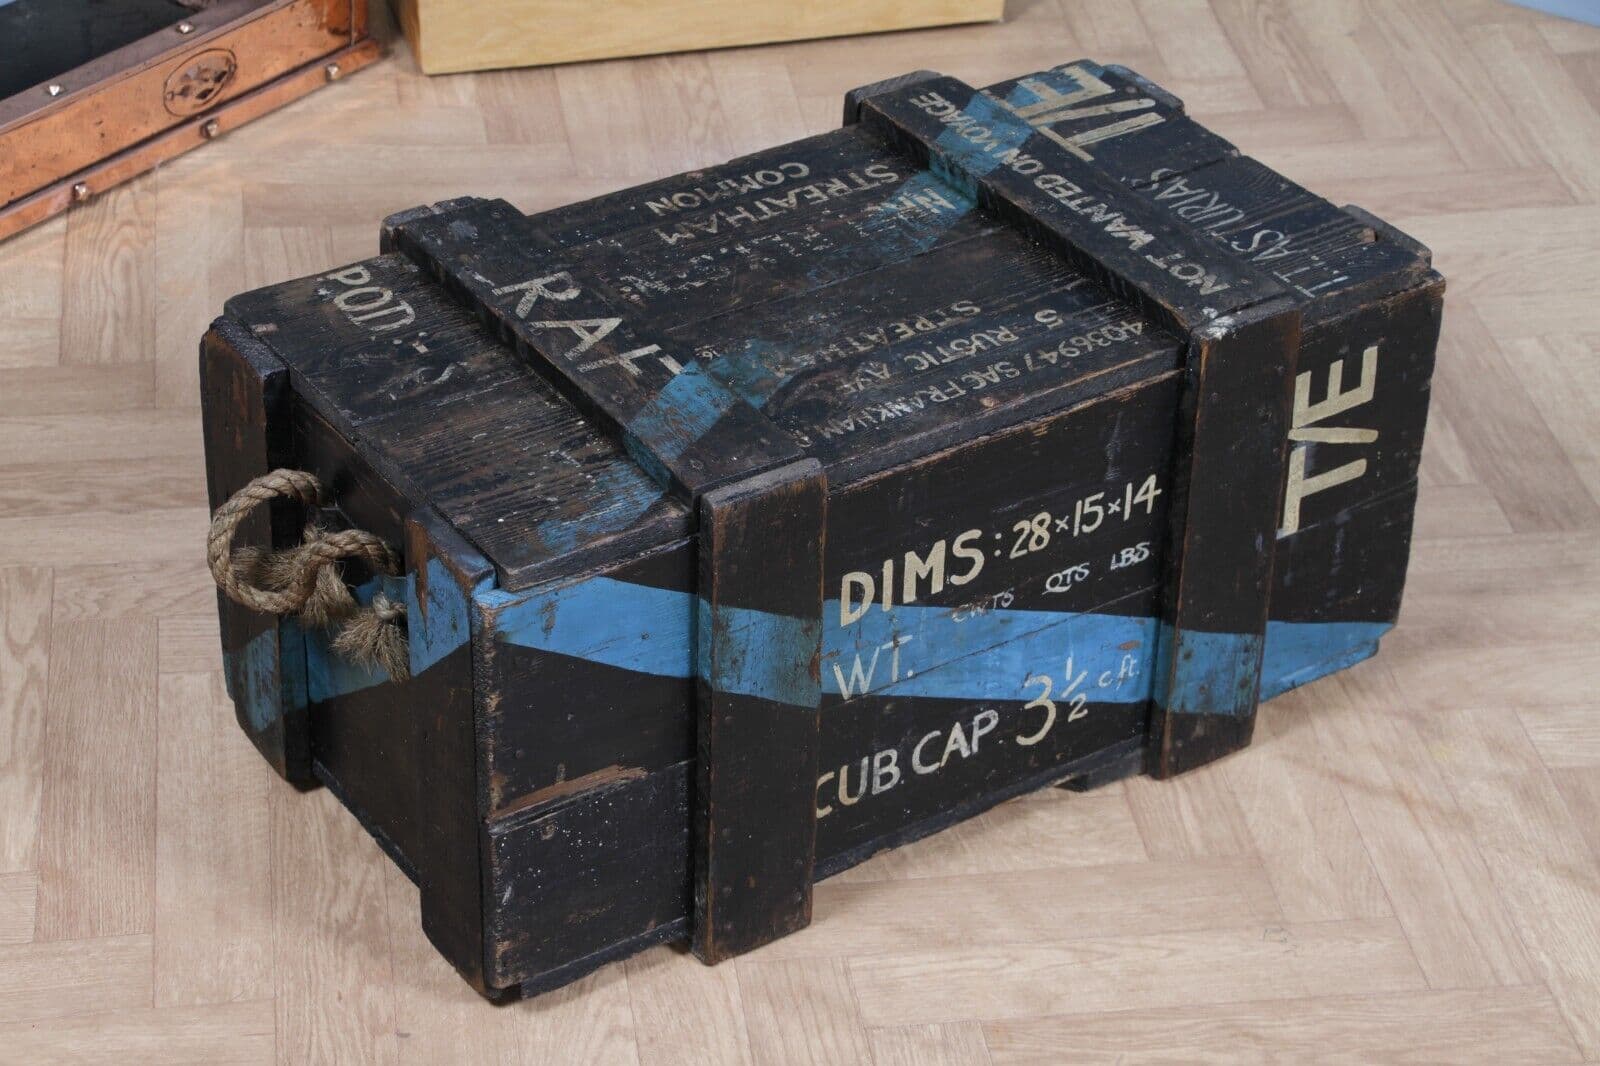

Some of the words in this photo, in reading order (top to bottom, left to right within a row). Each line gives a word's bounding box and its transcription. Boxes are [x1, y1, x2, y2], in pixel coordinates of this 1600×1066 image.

[909, 91, 999, 151] VOYAGE
[992, 148, 1045, 175] ON
[644, 162, 810, 216] COMMON
[652, 163, 899, 246] STREATHAM
[1034, 174, 1155, 251] WANTED
[1145, 253, 1231, 296] NOT
[491, 270, 684, 374] RAF
[904, 324, 1020, 371] RUSTIC
[1024, 319, 1144, 373] 4036947
[962, 361, 1022, 391] SAC
[1276, 345, 1379, 540] T/E
[1109, 541, 1152, 571] LBS
